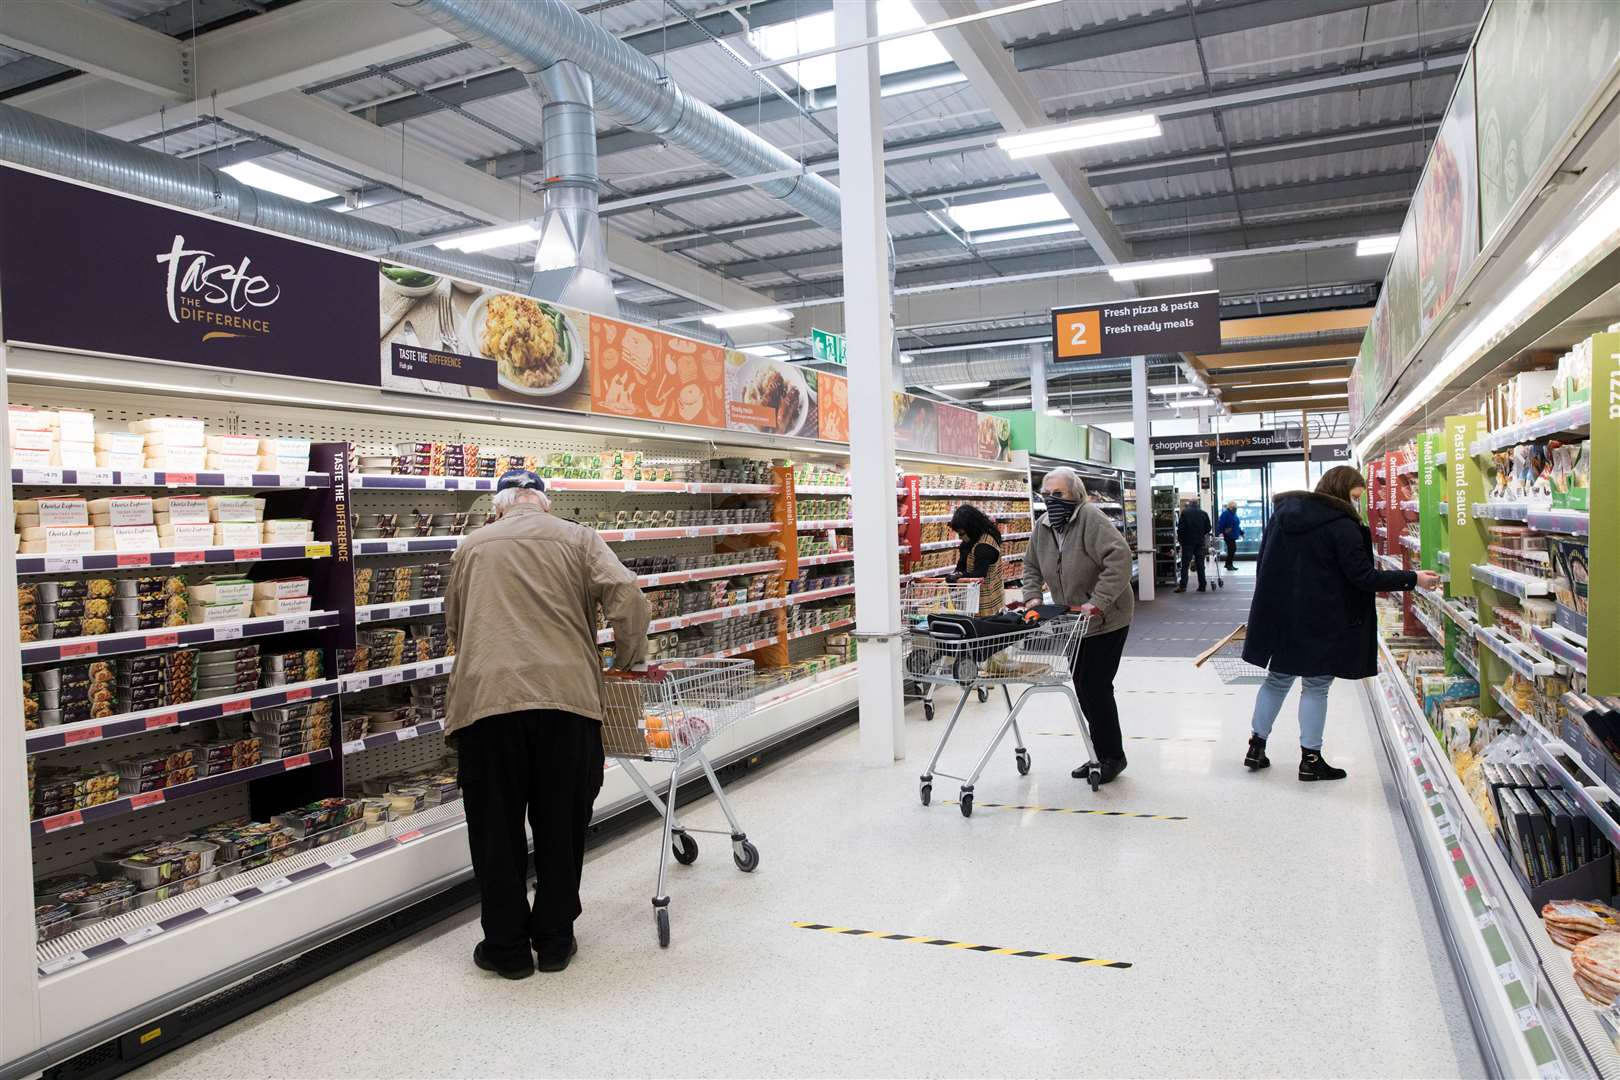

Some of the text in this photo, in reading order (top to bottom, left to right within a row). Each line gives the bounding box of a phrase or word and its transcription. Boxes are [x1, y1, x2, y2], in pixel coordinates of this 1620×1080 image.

[156, 234, 280, 323] taste
[180, 296, 201, 308] THE
[1104, 300, 1199, 318] Fresh pizza & pasta
[180, 308, 270, 333] DIFFERENCE
[1105, 318, 1194, 335] Fresh ready meals
[1070, 322, 1087, 346] 2
[399, 348, 462, 368] TASTE THE DIFFERENCE
[1155, 440, 1193, 450] shopping
[1194, 440, 1203, 448] at
[1205, 436, 1251, 447] Sainsbury's
[1390, 457, 1398, 487] Oriental
[1424, 441, 1435, 486] Meat free
[1454, 424, 1469, 526] Pasta and sauce
[334, 452, 348, 562] TASTE THE DIFFERENCE
[786, 501, 794, 526] meals
